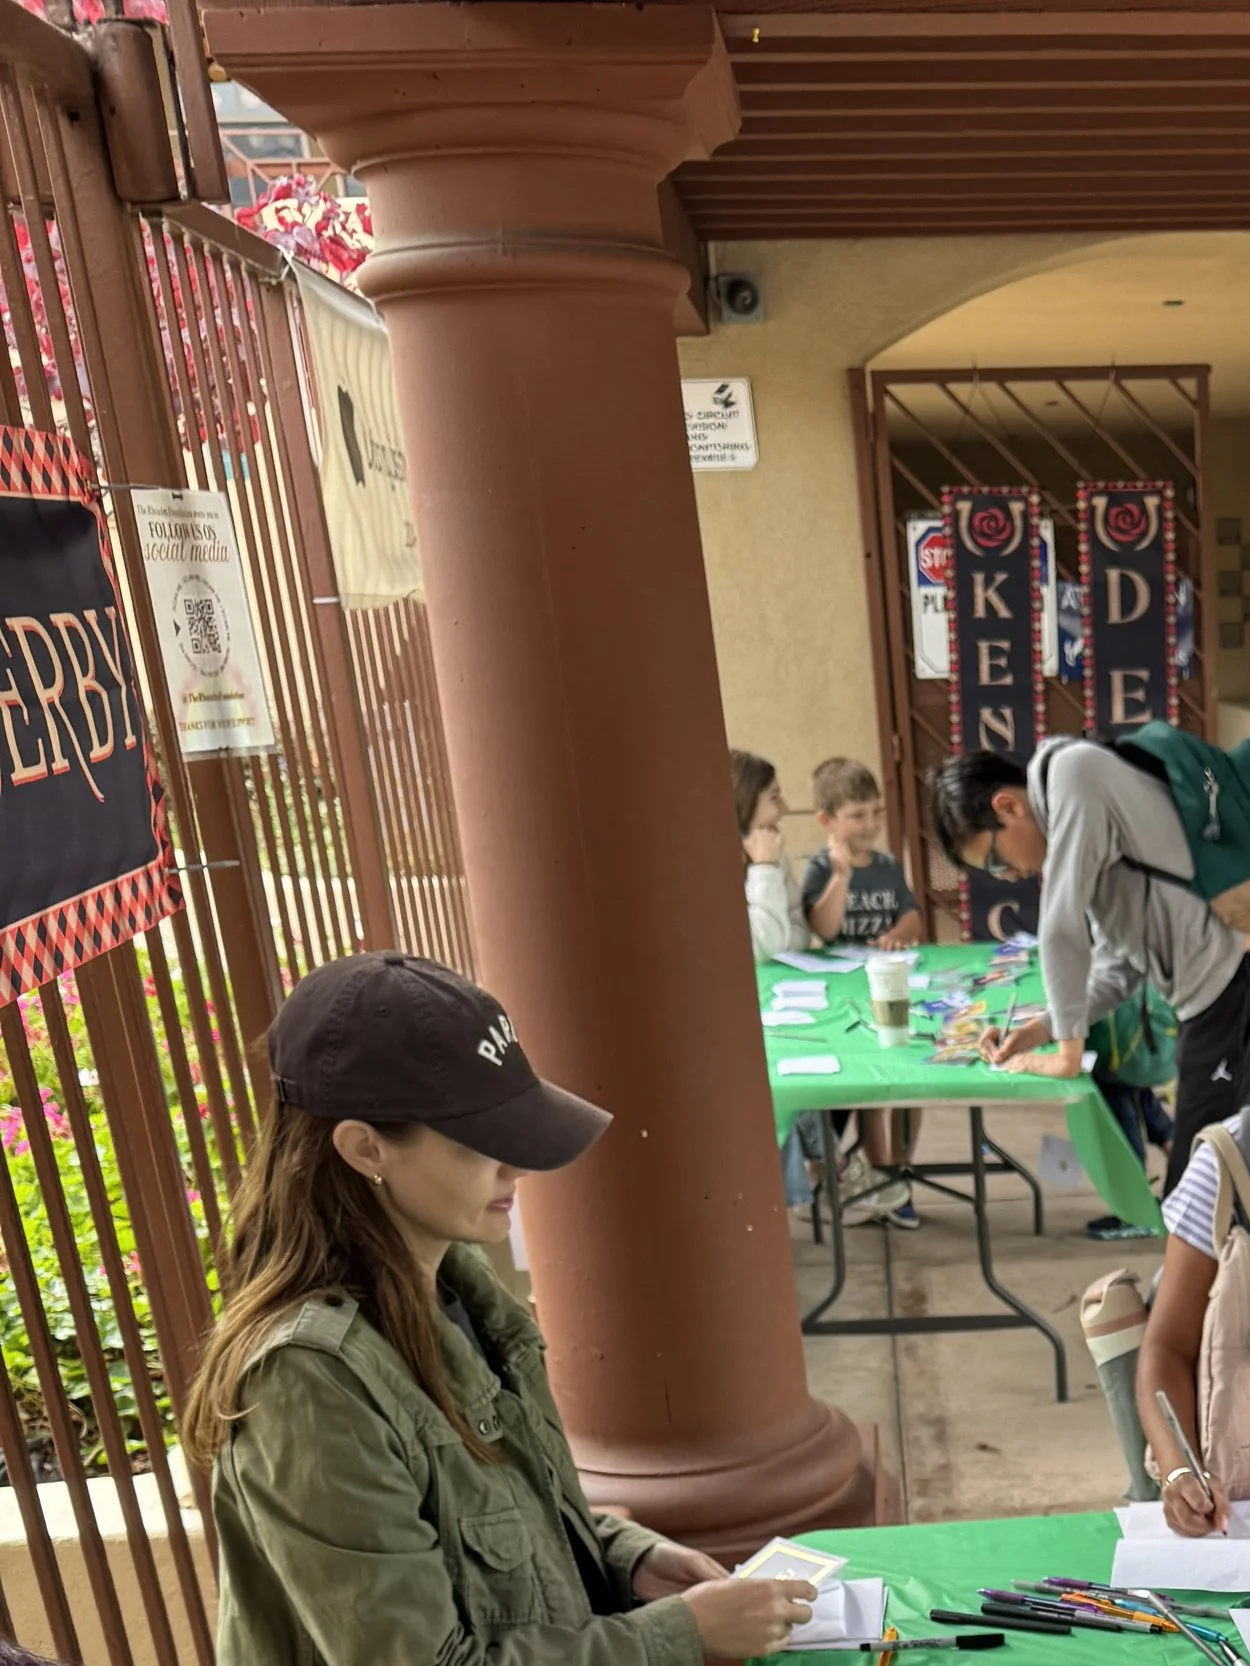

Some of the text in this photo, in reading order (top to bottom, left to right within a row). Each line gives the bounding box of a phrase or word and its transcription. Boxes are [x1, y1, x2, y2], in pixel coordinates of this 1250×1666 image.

[148, 521, 189, 540] FOLLOW
[144, 540, 230, 563] social media
[920, 547, 947, 569] ST
[0, 606, 137, 803] ERBY
